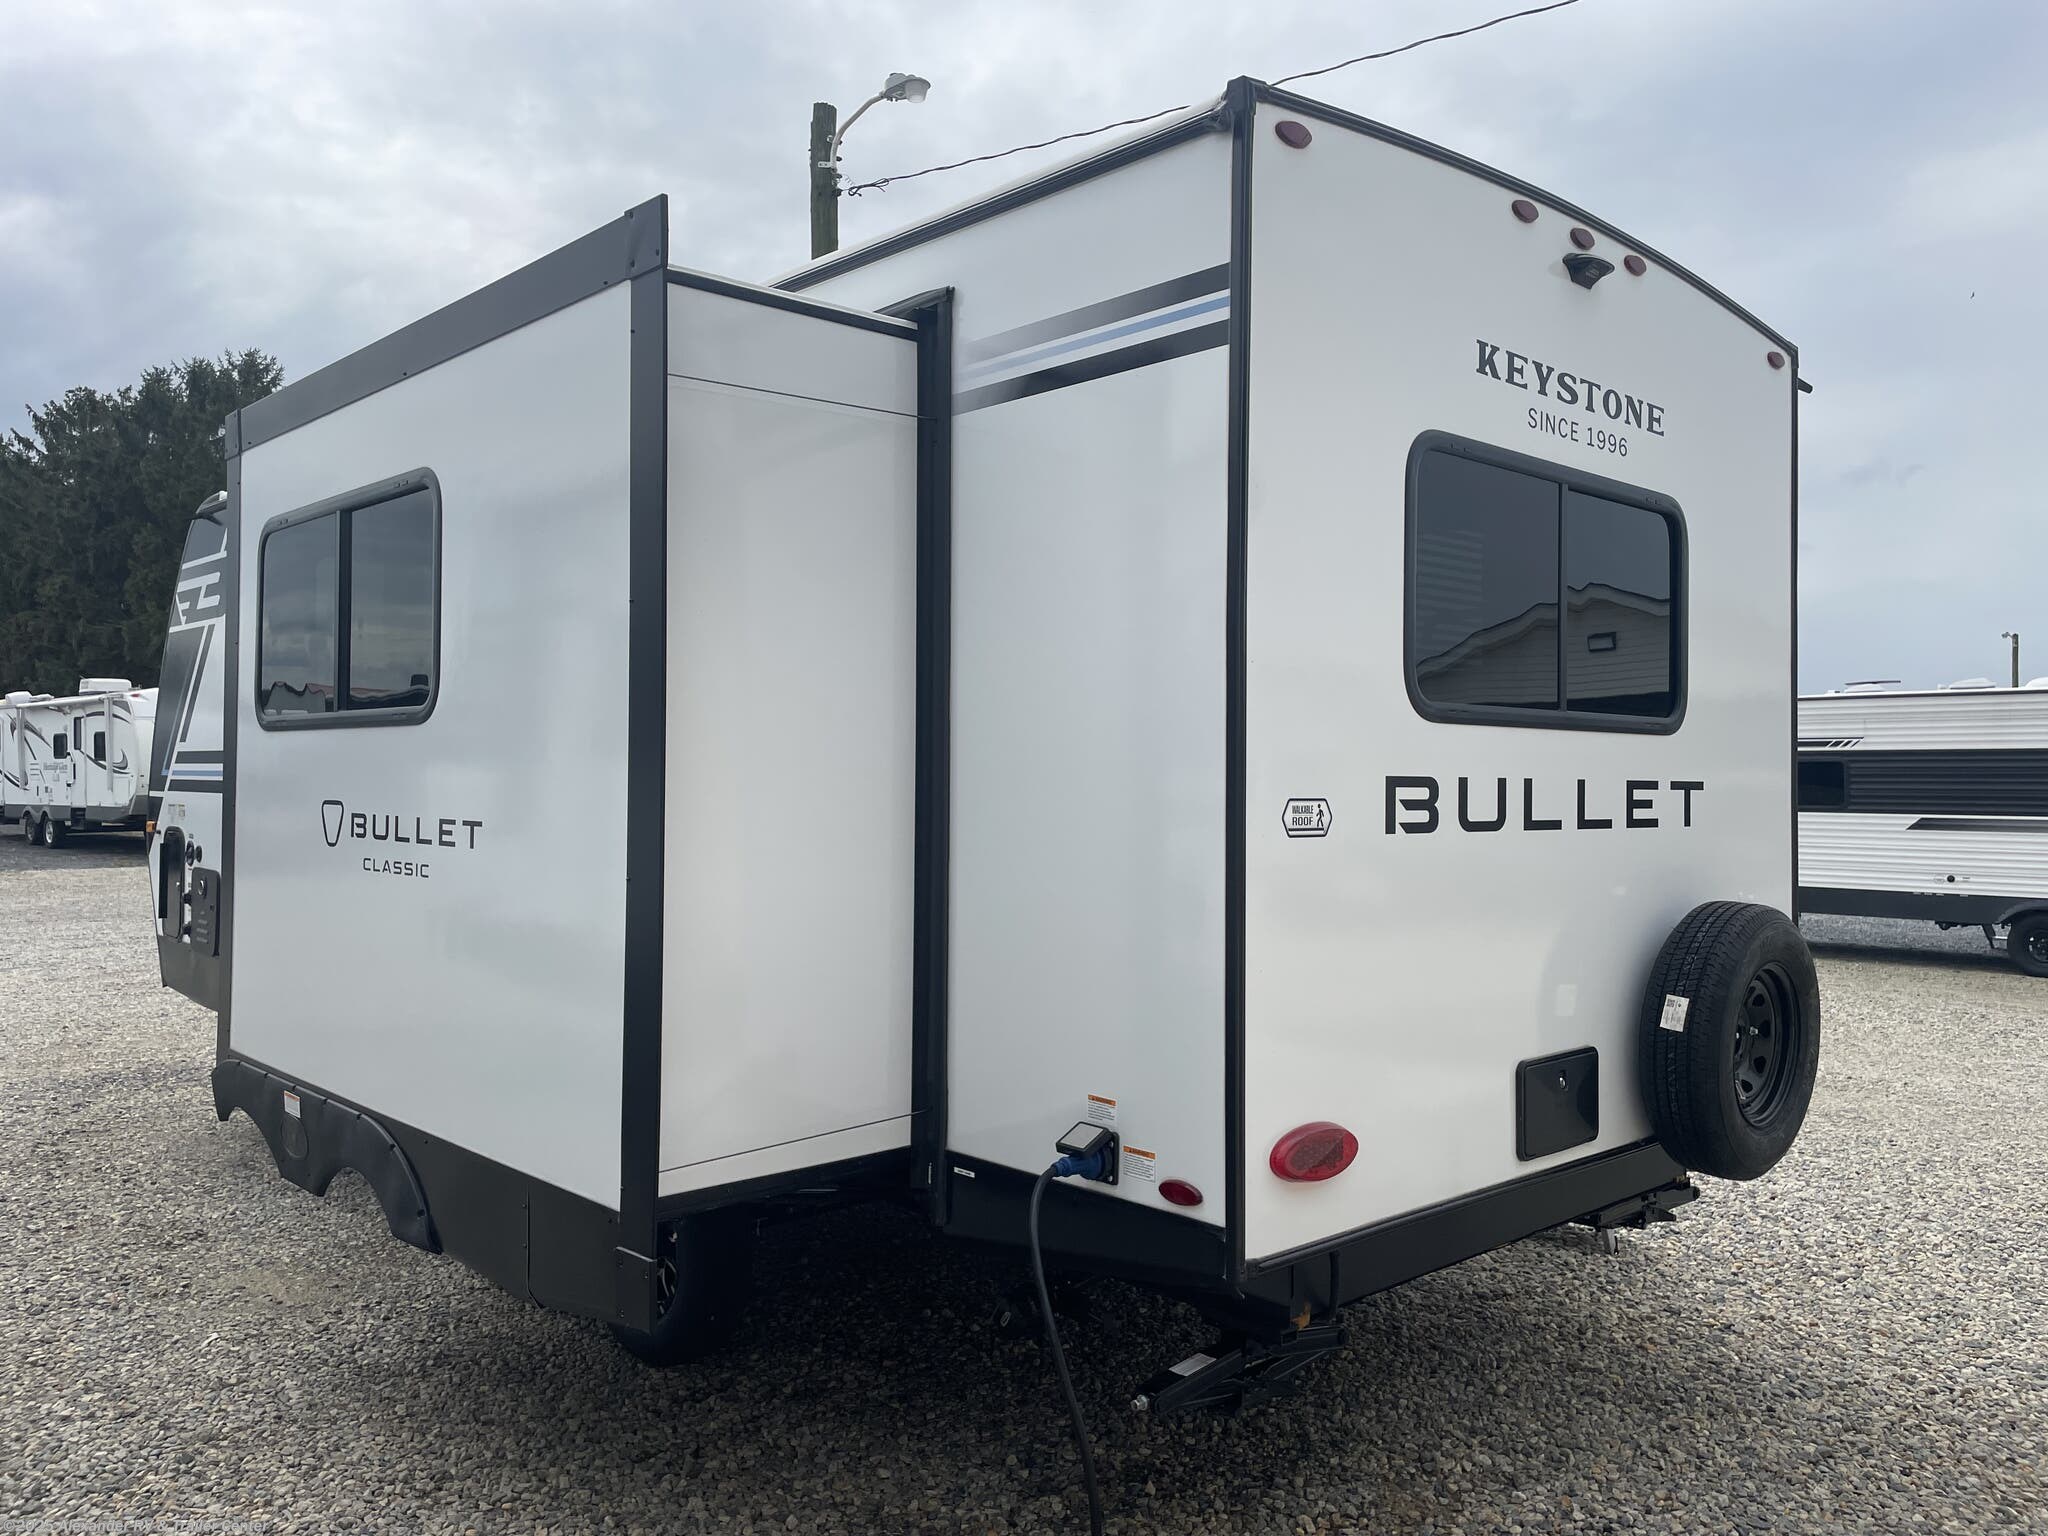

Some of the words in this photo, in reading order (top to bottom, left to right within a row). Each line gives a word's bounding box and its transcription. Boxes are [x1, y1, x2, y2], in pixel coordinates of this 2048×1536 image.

[1476, 339, 1665, 437] KEYSTONE
[1527, 407, 1580, 442] SINCE
[1586, 427, 1628, 457] 1996
[1291, 804, 1314, 815] WALKABLE
[1291, 816, 1314, 826] ROOF
[1385, 775, 1704, 835] BULLET
[350, 812, 483, 849] BULLET
[362, 857, 430, 879] CLASSIC
